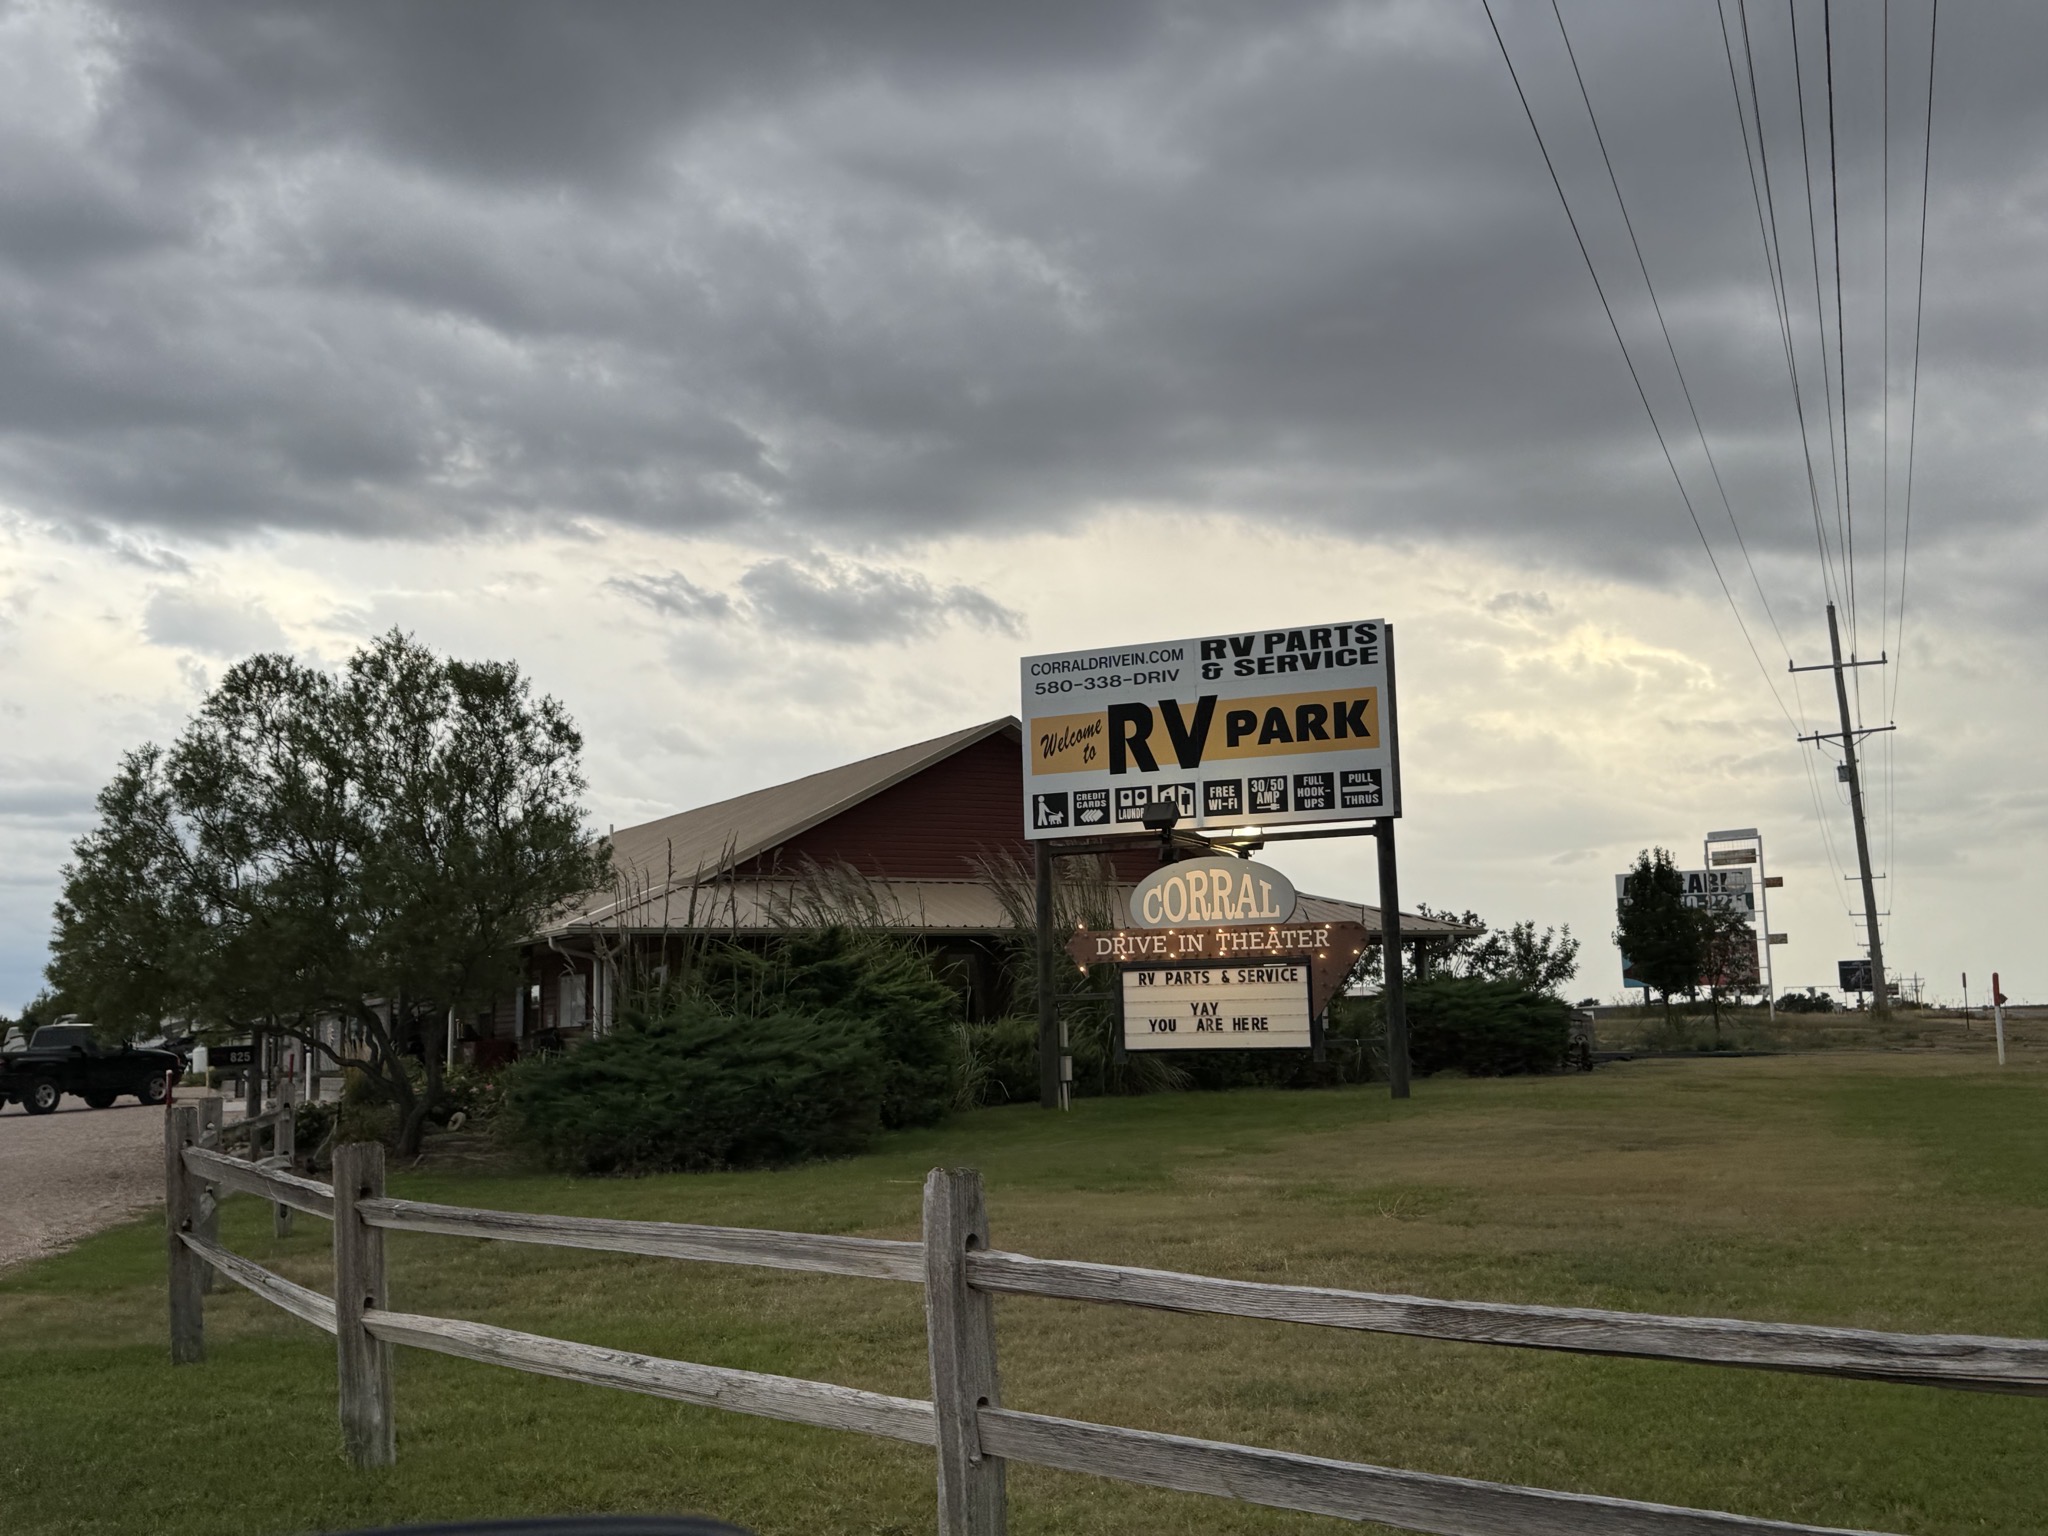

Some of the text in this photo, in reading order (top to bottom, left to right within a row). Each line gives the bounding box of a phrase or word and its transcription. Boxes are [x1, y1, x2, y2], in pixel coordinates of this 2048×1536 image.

[1200, 623, 1378, 661] RV PARTS
[1030, 648, 1184, 676] CORRALDRIVEIN.COM
[1201, 646, 1379, 680] & SERVICE
[1034, 669, 1180, 695] 580-338-DRIV
[1040, 718, 1102, 759] Welcome
[1108, 694, 1371, 775] RV PARK
[1083, 742, 1097, 764] to
[1251, 778, 1285, 793] 30/50
[1303, 775, 1324, 786] FULL
[1348, 773, 1373, 784] PULL
[1076, 791, 1107, 801] CREDIT
[1209, 785, 1235, 799] FREE
[1256, 791, 1280, 805] AMP
[1297, 787, 1331, 798] HOOK-
[1076, 800, 1107, 809] CARDS
[1208, 799, 1238, 811] WI-FI
[1304, 798, 1325, 809] UPS
[1344, 794, 1379, 805] THRUS
[1142, 868, 1281, 924] CORRAL
[1096, 929, 1330, 955] DRIVE IN THEATER
[1138, 968, 1298, 986] RV PARTS & SERVICE
[1190, 1002, 1219, 1016] YAY
[1149, 1017, 1269, 1032] YOU ARE HERE
[230, 1051, 251, 1063] 825
